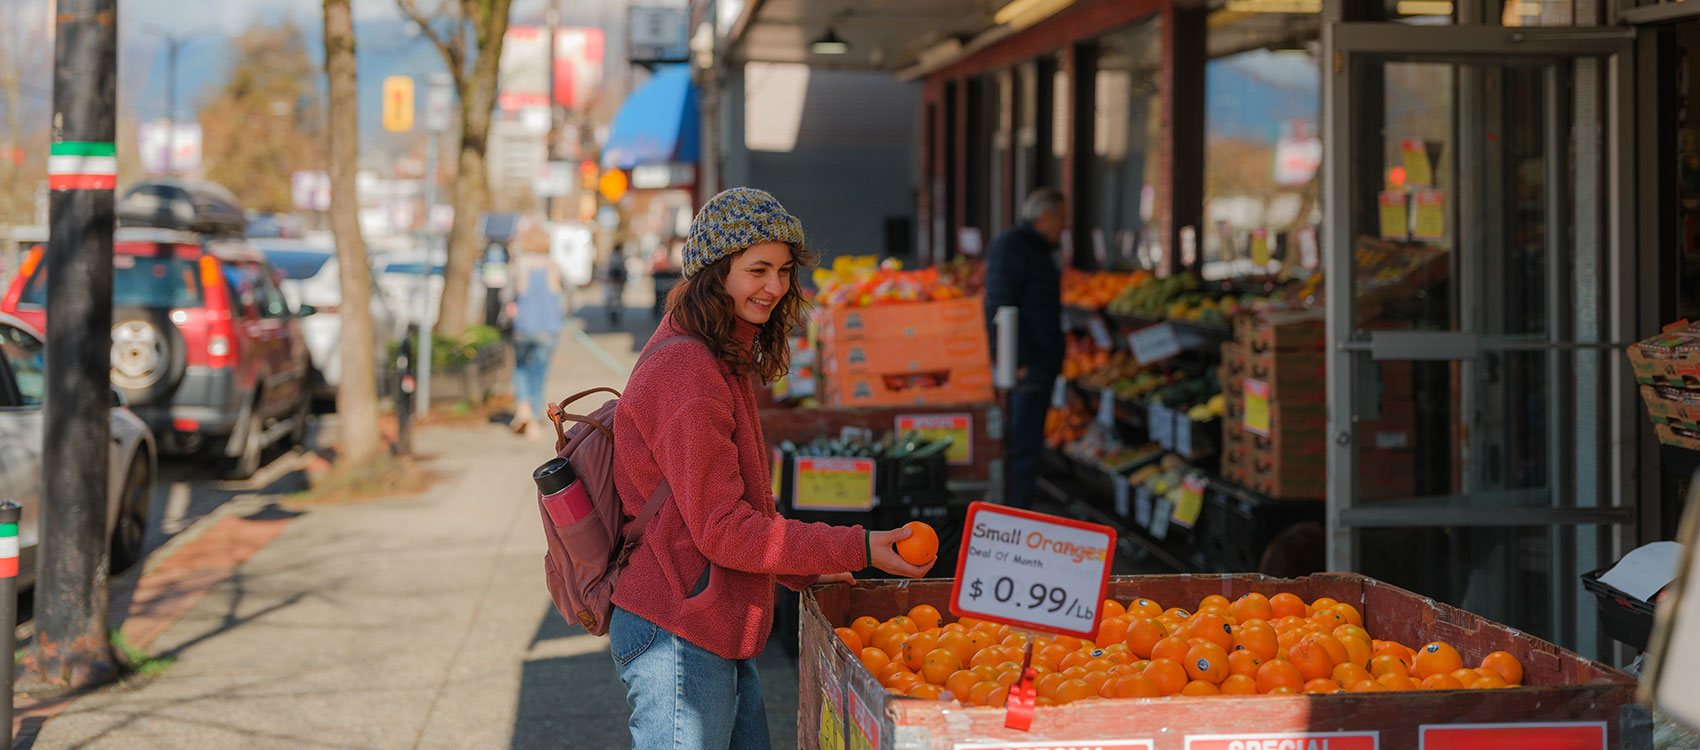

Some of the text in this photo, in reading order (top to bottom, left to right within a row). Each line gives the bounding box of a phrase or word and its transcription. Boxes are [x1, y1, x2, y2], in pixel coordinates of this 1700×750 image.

[973, 523, 1107, 563] Small Oranges
[969, 547, 1043, 568] Deal Of Month
[969, 578, 983, 601] $
